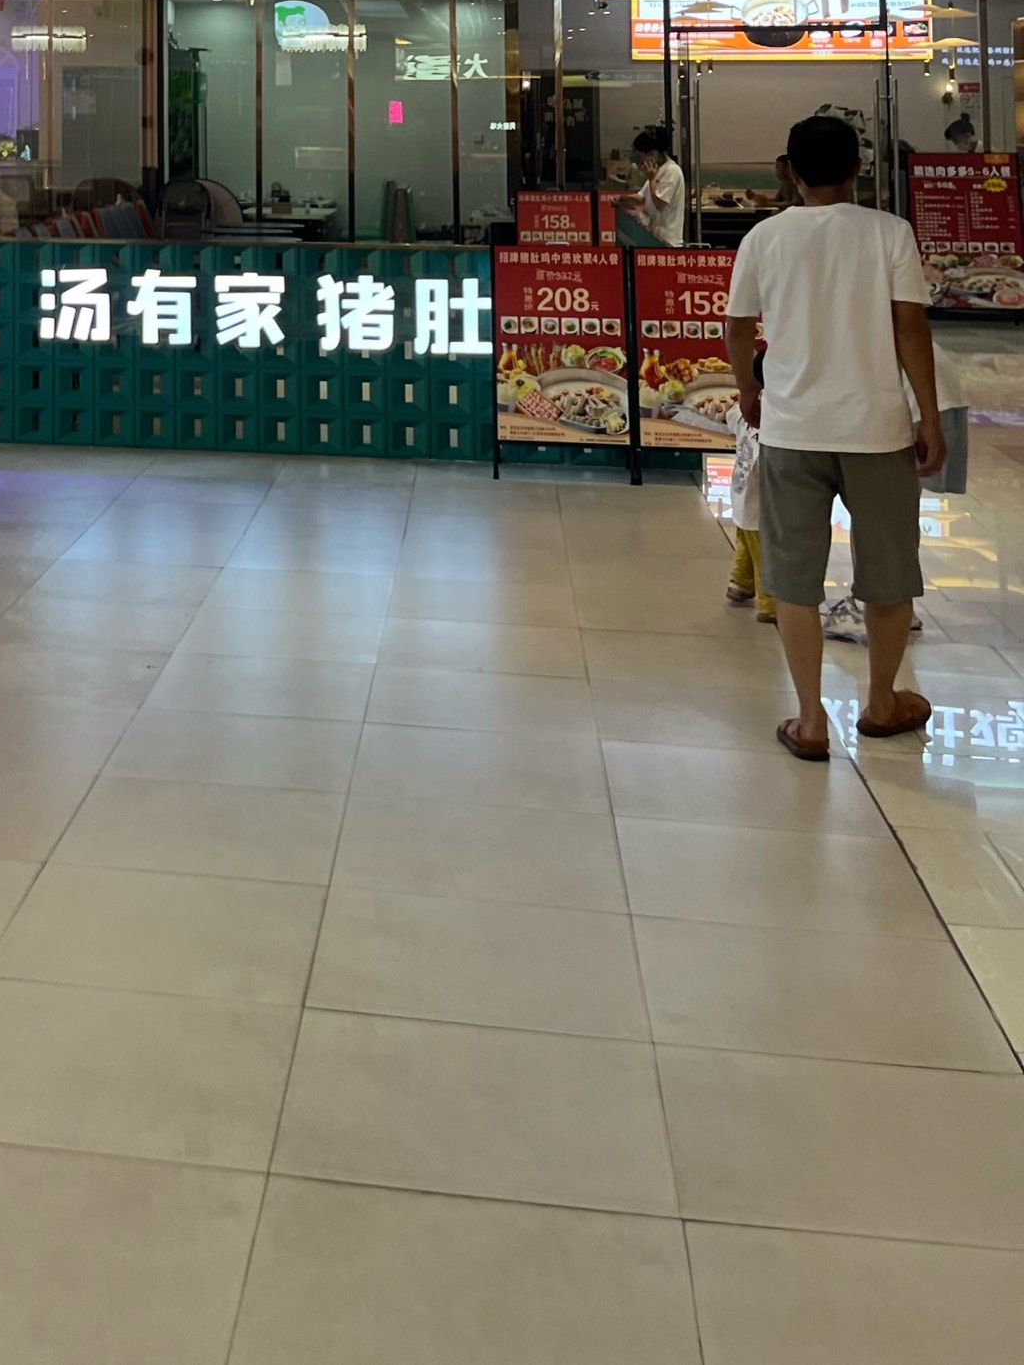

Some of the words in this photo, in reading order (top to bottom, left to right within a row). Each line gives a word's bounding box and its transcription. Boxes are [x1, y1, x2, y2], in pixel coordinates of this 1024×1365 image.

[541, 214, 576, 230] 158
[637, 254, 735, 268] 招牌猪肚鸡小煲欢聚2
[38, 267, 492, 355] 汤有家猪肚
[678, 290, 729, 315] 158
